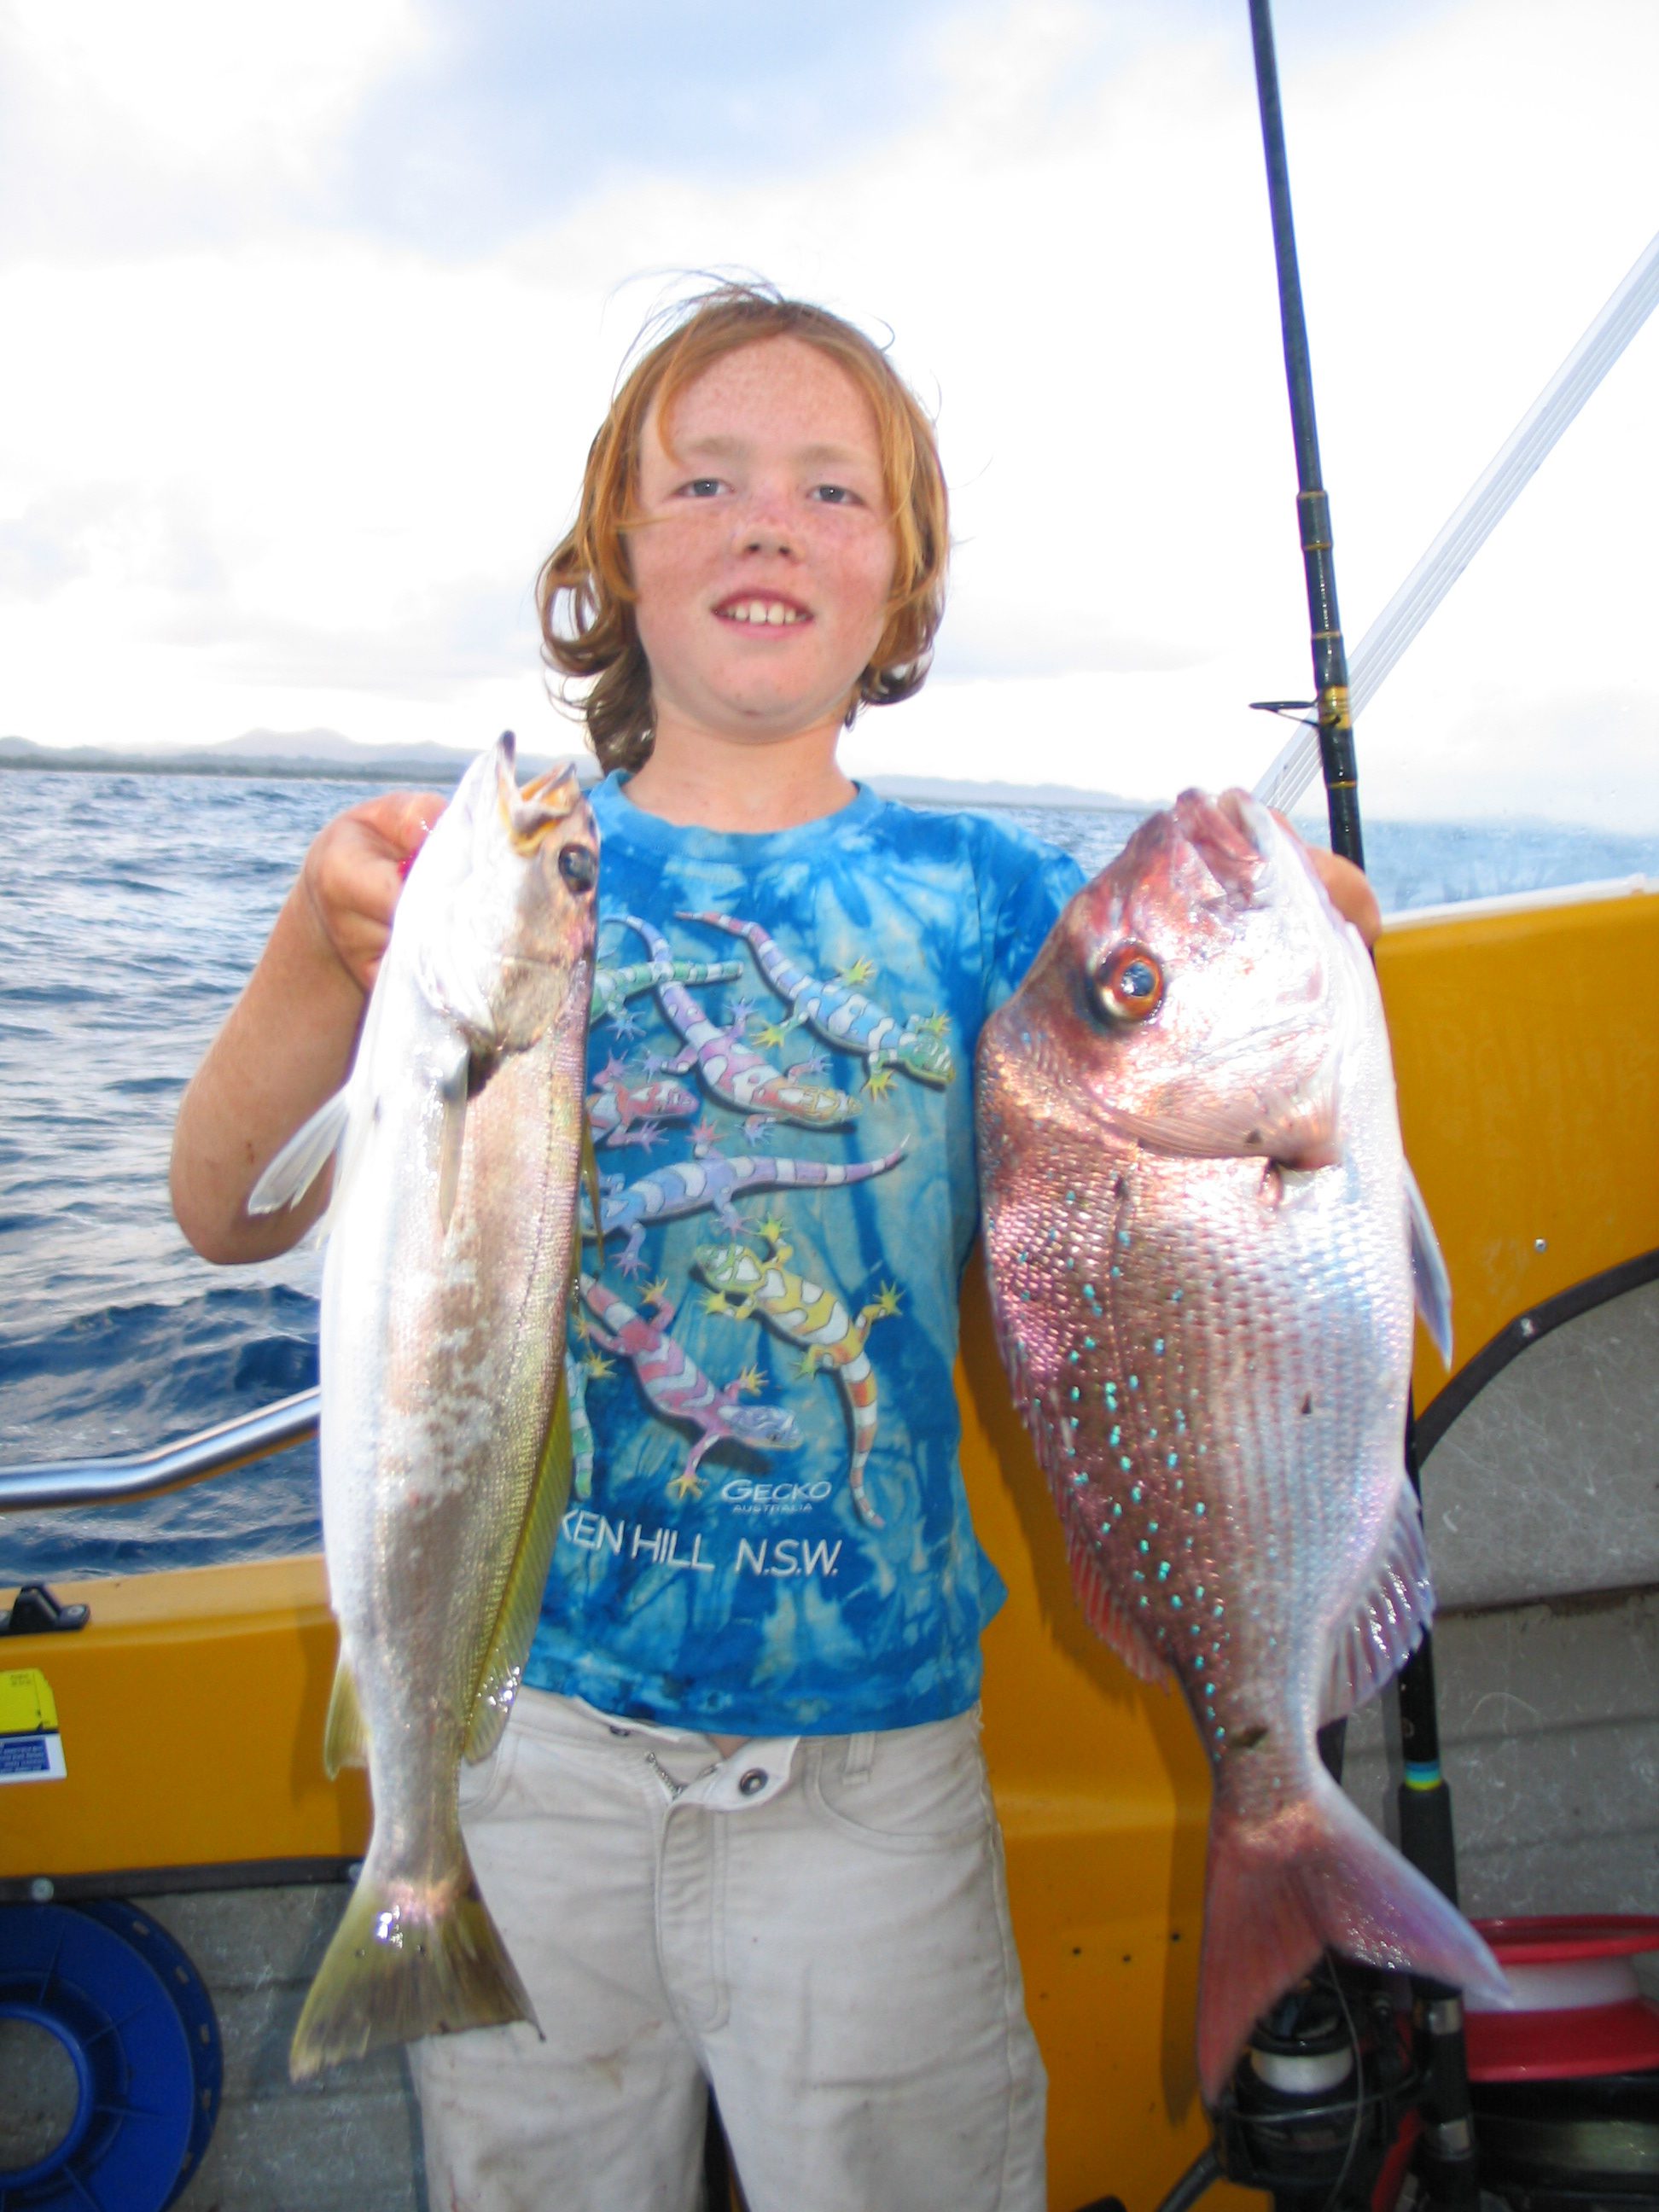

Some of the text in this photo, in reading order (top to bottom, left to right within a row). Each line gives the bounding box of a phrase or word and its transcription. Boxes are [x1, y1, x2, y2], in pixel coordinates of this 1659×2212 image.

[721, 1479, 832, 1503] GECKO
[732, 1503, 812, 1515] AUSTRALIA
[632, 1524, 715, 1569] HILL
